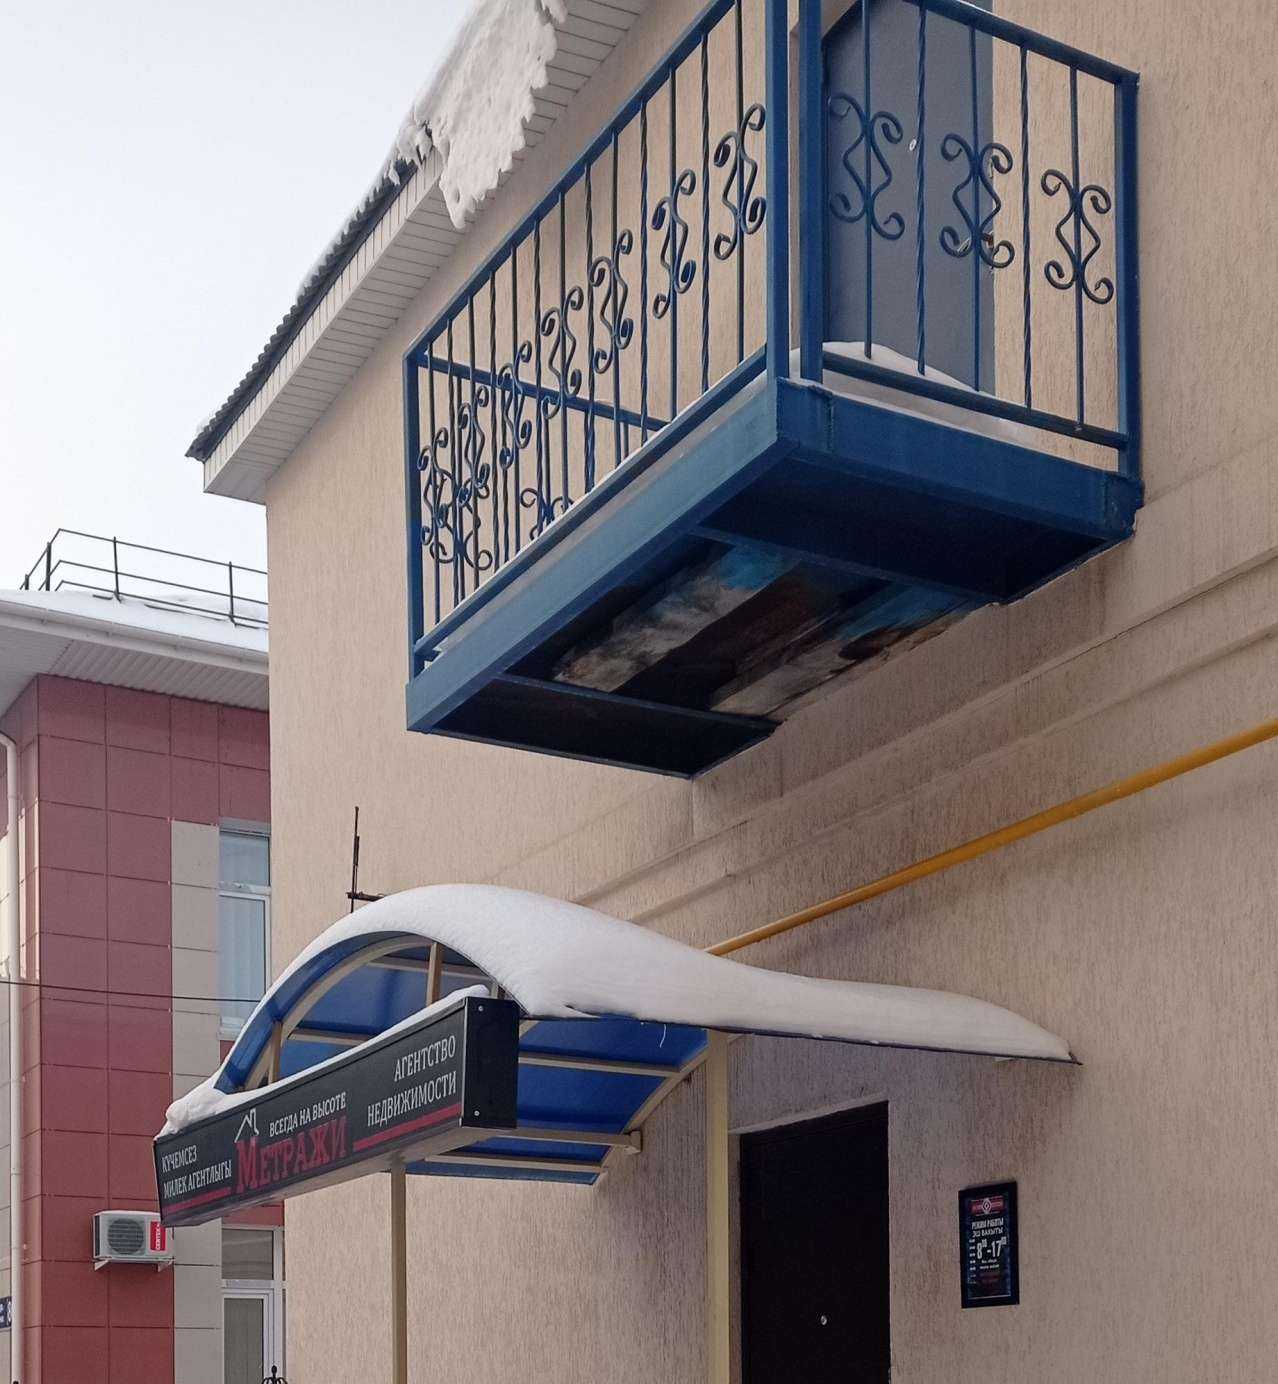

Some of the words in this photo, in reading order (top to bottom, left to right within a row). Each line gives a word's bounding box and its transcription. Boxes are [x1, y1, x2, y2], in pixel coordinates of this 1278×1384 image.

[394, 1035, 456, 1082] АГЕНТСТВО
[269, 1113, 298, 1137] ВСЕГДА
[299, 1108, 311, 1125] НА
[312, 1091, 346, 1120] ВЫСОТЕ
[367, 1070, 457, 1127] НЕДВИЖИМОСТИ
[235, 1116, 346, 1193] МЕТРАЖИ
[163, 1176, 188, 1199] МИЛЕК
[188, 1160, 232, 1191] АГЕНТЛЫГЫ
